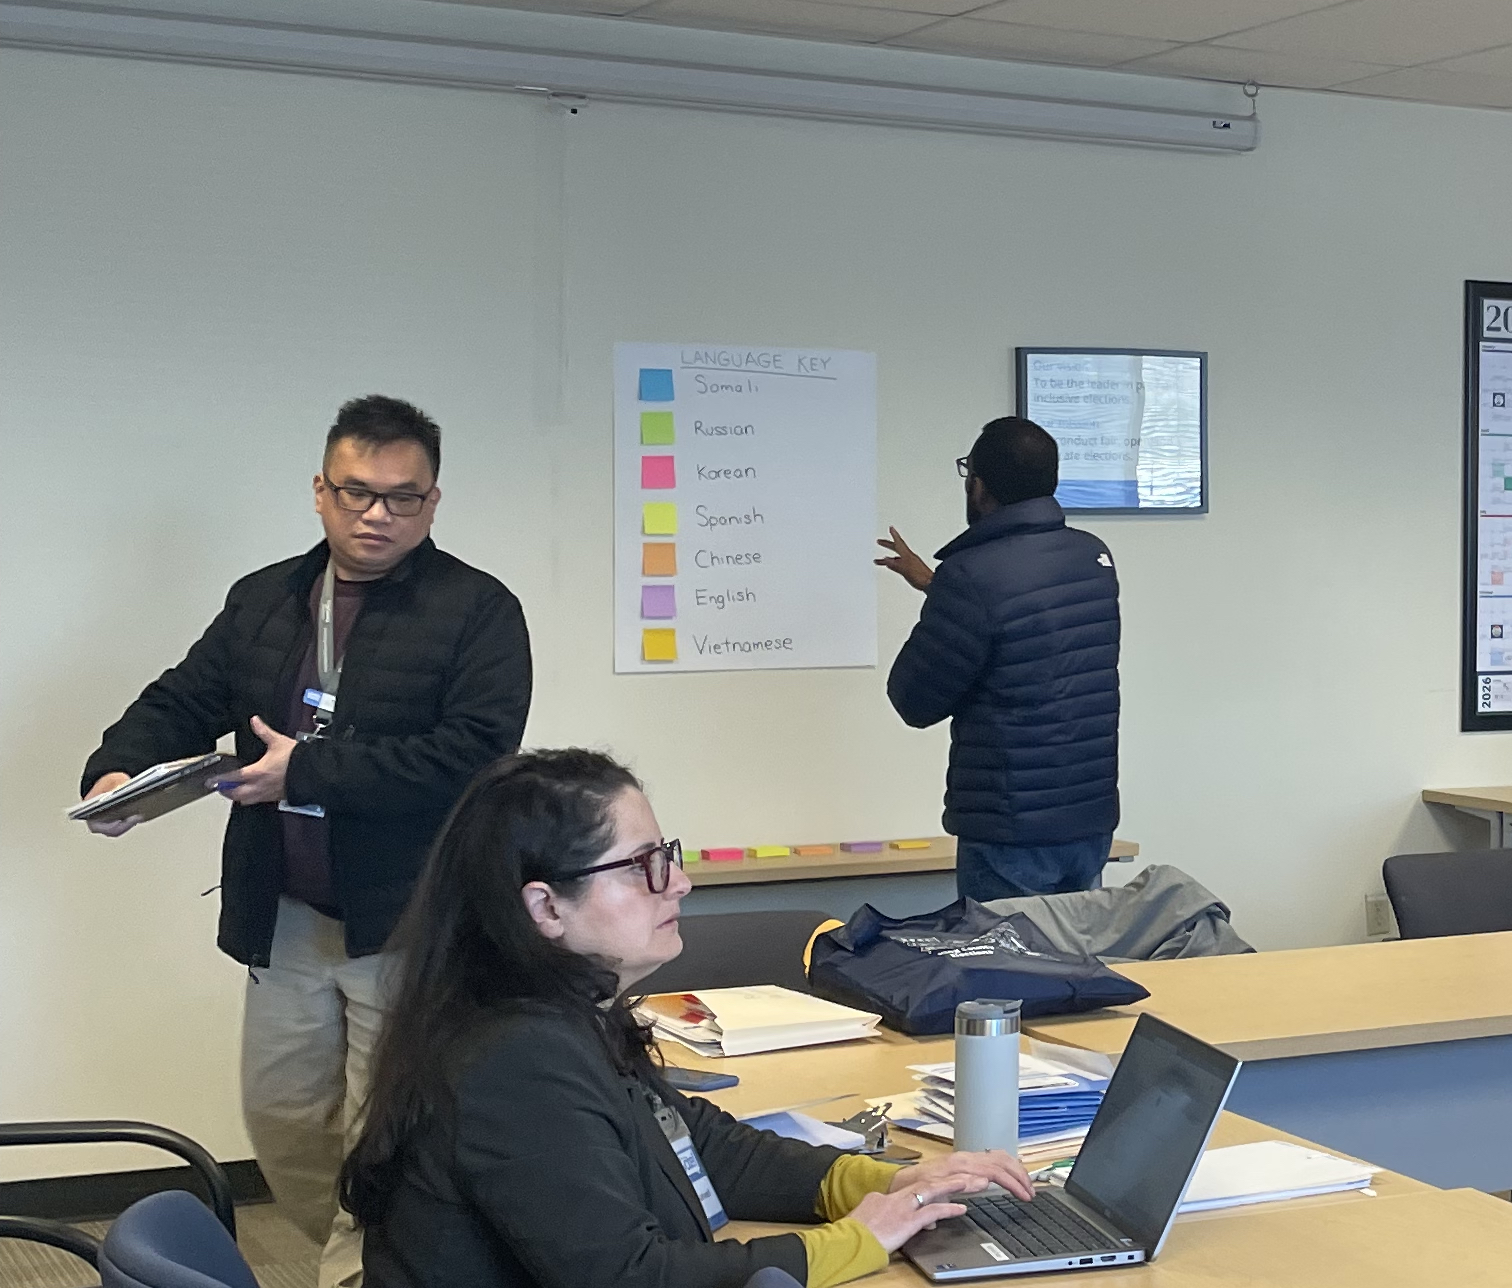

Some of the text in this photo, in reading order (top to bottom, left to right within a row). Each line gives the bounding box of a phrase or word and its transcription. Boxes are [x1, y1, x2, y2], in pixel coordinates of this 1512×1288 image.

[680, 351, 832, 373] LANGUAGE KEY
[695, 374, 759, 394] Somali
[1066, 379, 1084, 390] the
[694, 420, 755, 436] Russian
[697, 464, 757, 480] Korean
[695, 504, 765, 531] Spanish
[694, 549, 763, 569] Chinese
[695, 588, 757, 610] English
[693, 633, 793, 655] Vietnamese
[1481, 676, 1492, 709] 2026
